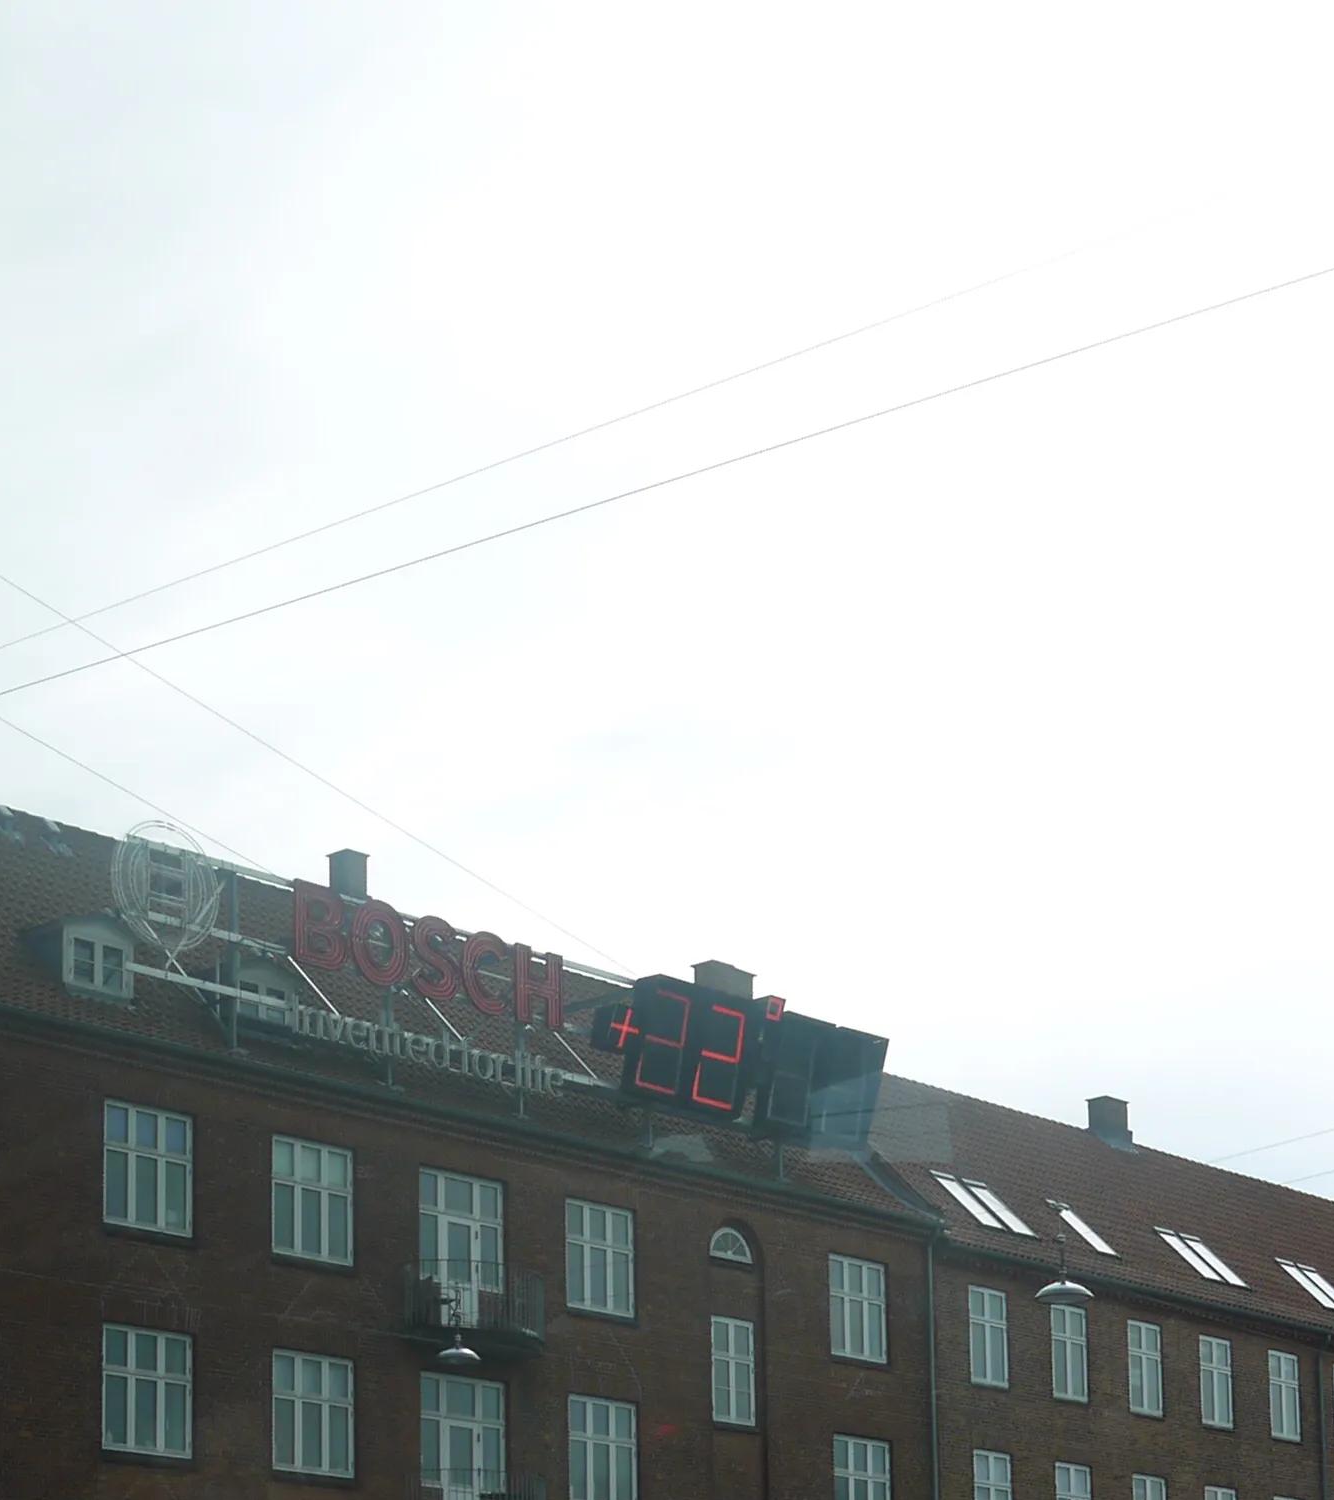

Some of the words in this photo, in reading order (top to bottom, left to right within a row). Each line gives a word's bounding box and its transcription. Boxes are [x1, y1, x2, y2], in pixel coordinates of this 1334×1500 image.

[293, 879, 564, 1030] BOSCH
[460, 1035, 510, 1084] for
[517, 1048, 565, 1096] life
